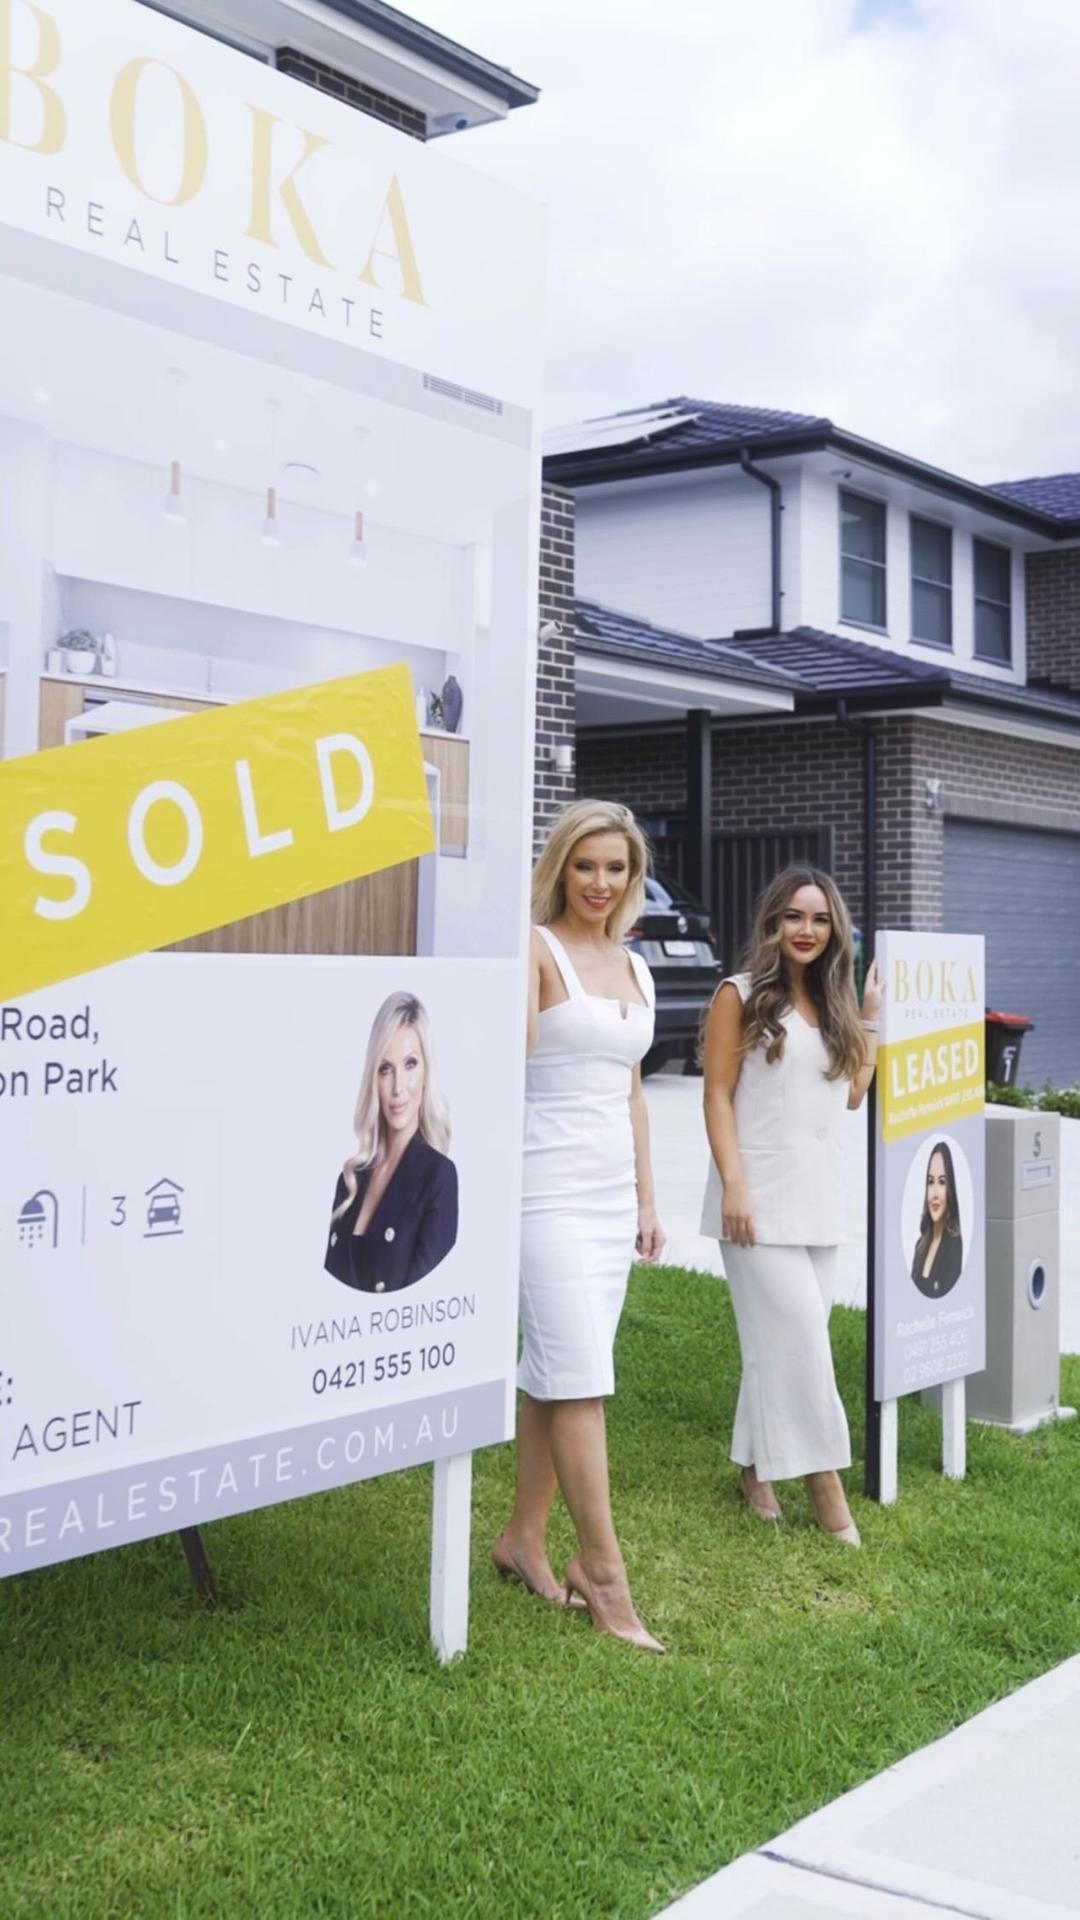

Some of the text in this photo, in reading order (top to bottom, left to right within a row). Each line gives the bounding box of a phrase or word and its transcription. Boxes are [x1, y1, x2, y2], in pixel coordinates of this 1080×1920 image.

[0, 0, 430, 307] BOKA
[46, 186, 383, 338] REAL ESTATE
[23, 732, 375, 921] SOLD
[894, 959, 978, 1003] BOKA
[1, 1005, 98, 1045] Road,
[44, 1059, 118, 1095] Park
[891, 1039, 979, 1099] LEASED
[110, 1196, 126, 1226] 3
[291, 1294, 476, 1350] IVANA ROBINSON
[312, 1342, 456, 1394] 0421 555 100
[12, 1400, 142, 1461] AGENT
